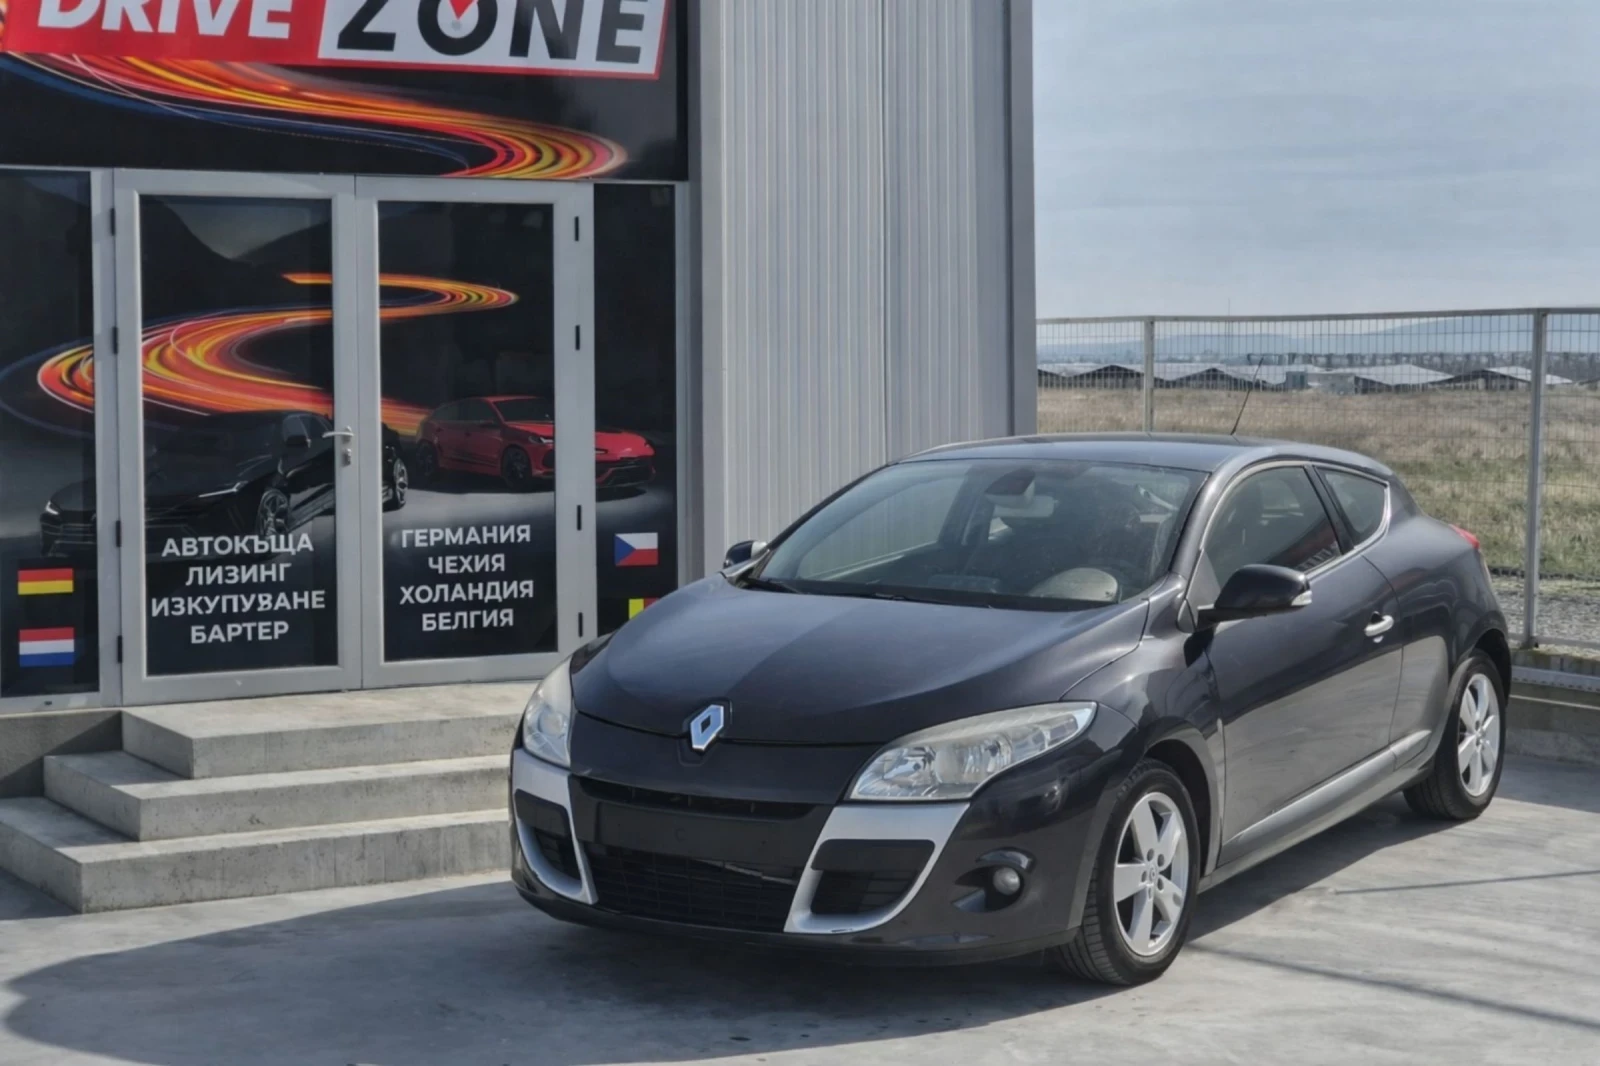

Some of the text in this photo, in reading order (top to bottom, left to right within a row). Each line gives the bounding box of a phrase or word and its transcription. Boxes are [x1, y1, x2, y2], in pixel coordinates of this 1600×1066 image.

[336, 0, 647, 64] ZONE
[161, 533, 314, 557] АВТОКЪЩА
[402, 524, 531, 548] ГЕРМАНИЯ
[185, 563, 292, 586] ЛИЗИНГ
[428, 553, 505, 574] ЧЕХИЯ
[151, 590, 326, 617] ИЗКУПУВАНЕ
[400, 580, 534, 605] ХОЛАНДИЯ
[422, 608, 514, 632] БЕЛГИЯ
[191, 621, 289, 644] БАРТЕР
